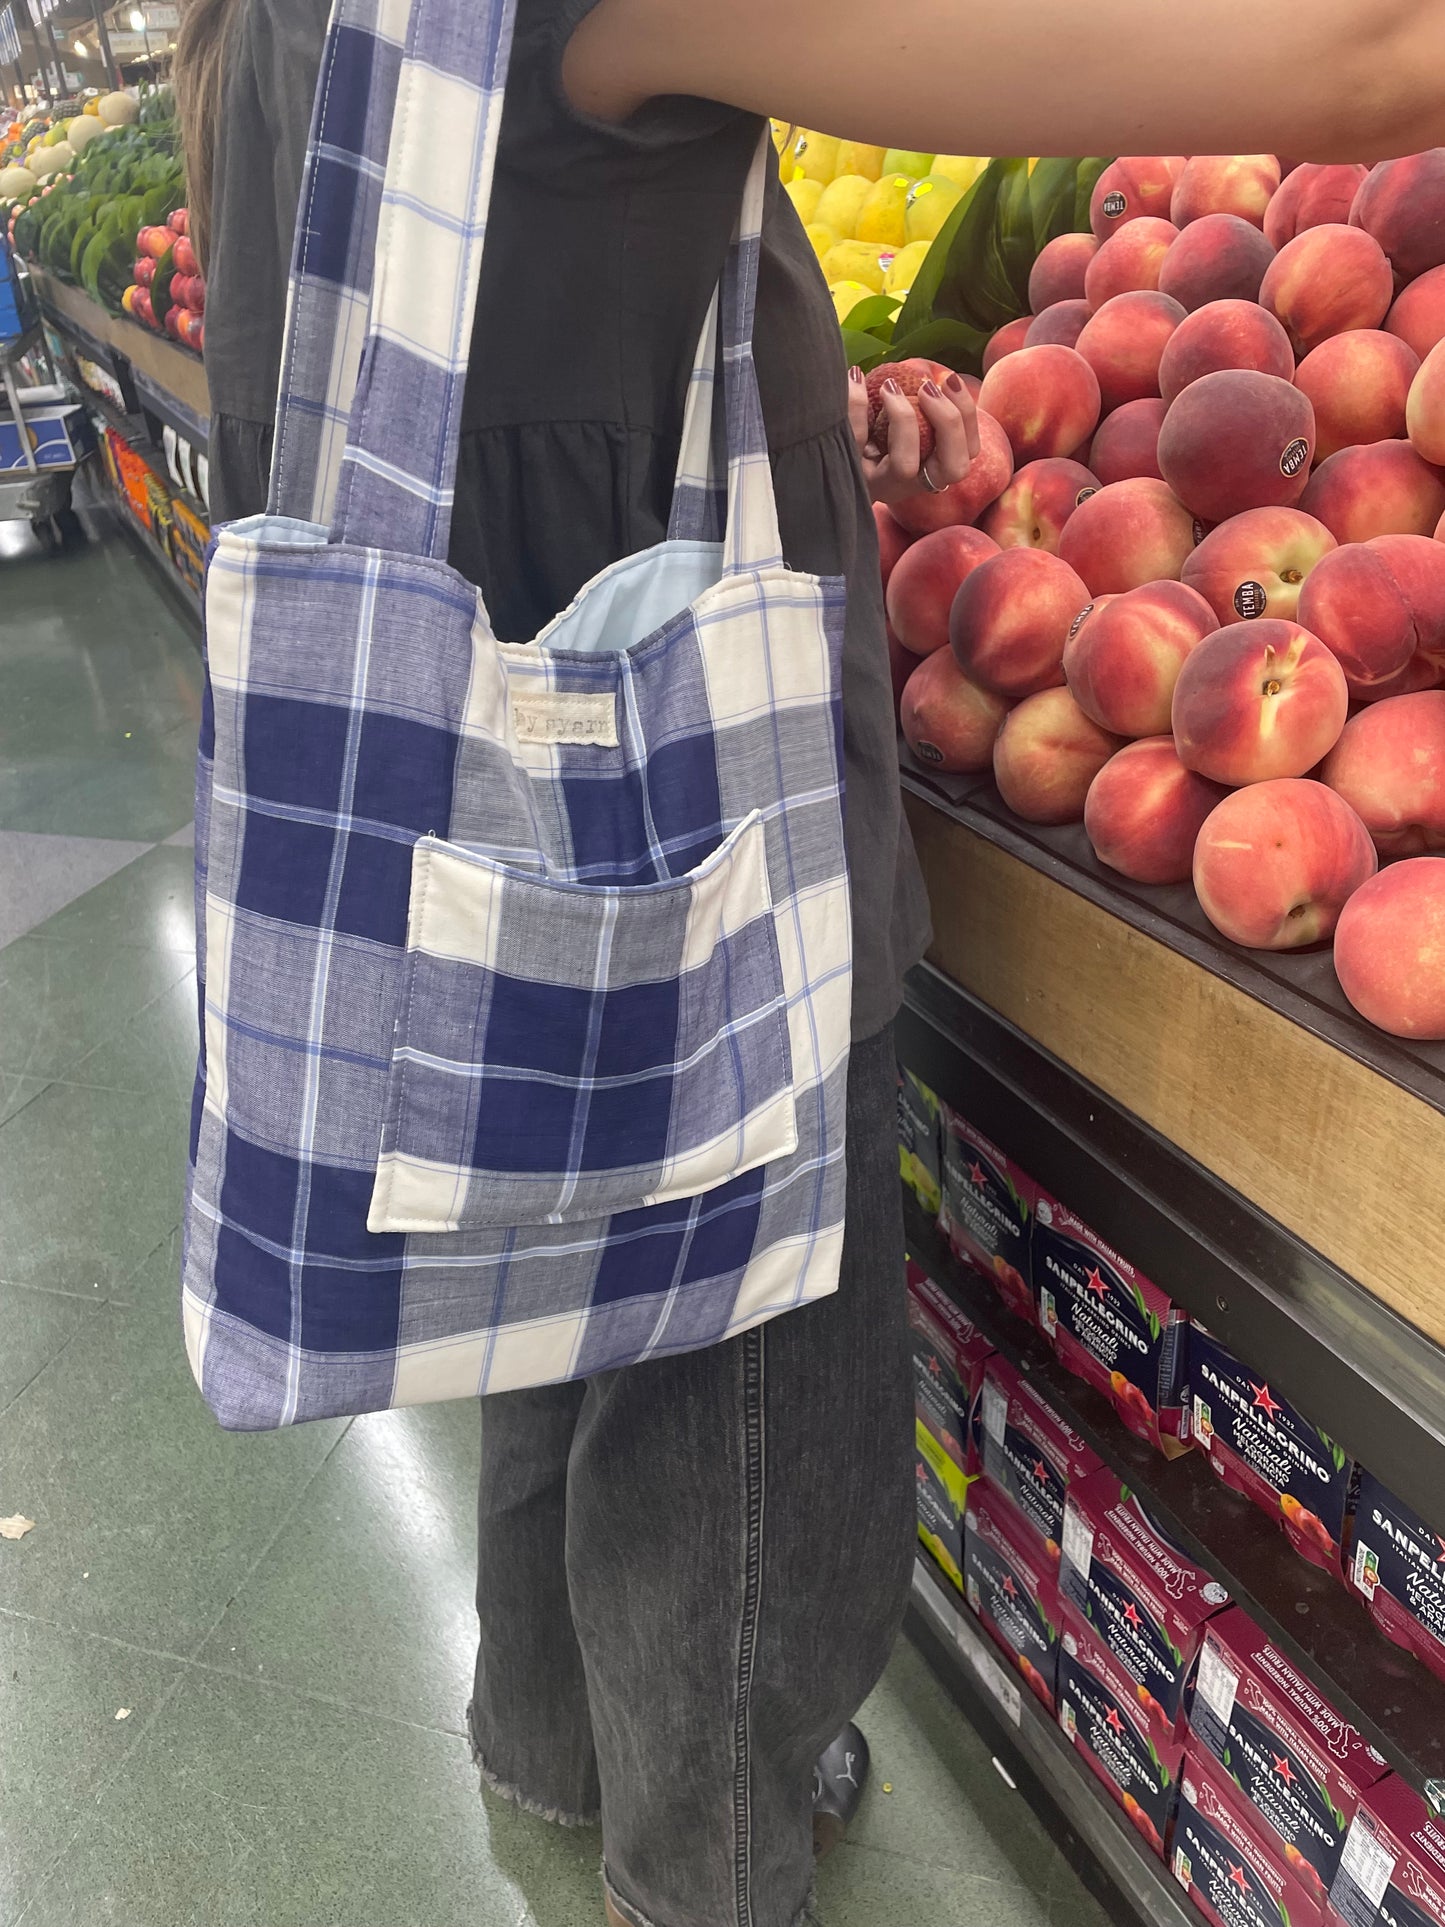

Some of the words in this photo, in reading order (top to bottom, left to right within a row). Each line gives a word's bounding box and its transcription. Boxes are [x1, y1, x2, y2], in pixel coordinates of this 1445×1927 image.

[1283, 445, 1307, 473] TEMBA
[1241, 583, 1255, 616] TEMBA
[1045, 1255, 1149, 1355] SANPELLEGRINO
[1070, 1302, 1119, 1353] Naturali
[1236, 1376, 1251, 1391] DAL
[1278, 1412, 1296, 1431] 1932
[1201, 1363, 1331, 1484] SANPELLEGRINO
[1218, 1393, 1244, 1418] ITALIAN
[1282, 1450, 1309, 1476] DRINKS
[1231, 1417, 1293, 1475] Naturali
[1107, 1510, 1137, 1542] INGREDIENTS
[1114, 1505, 1133, 1526] FRUITS
[1129, 1523, 1151, 1546] ITALIAN
[1418, 1526, 1437, 1547] DAL
[1134, 1540, 1156, 1564] NATURAL
[1148, 1542, 1163, 1560] WITH
[1160, 1556, 1177, 1575] MADE
[1392, 1543, 1423, 1574] ITALIAN
[1153, 1560, 1170, 1580] 100%
[1088, 1578, 1176, 1684] SANPELLEGRINO
[1254, 1652, 1290, 1693] INGREDIENTS
[1262, 1646, 1286, 1671] FRUITS
[1282, 1667, 1305, 1693] ITALIAN
[1288, 1690, 1312, 1717] NATURAL
[1303, 1690, 1322, 1712] WITH
[1312, 1713, 1332, 1736] 100%
[1321, 1709, 1341, 1730] MADE
[1068, 1678, 1159, 1795] SANPELLEGRINO
[1229, 1724, 1335, 1848] SANPELLEGRINO
[1250, 1775, 1301, 1834] Naturali
